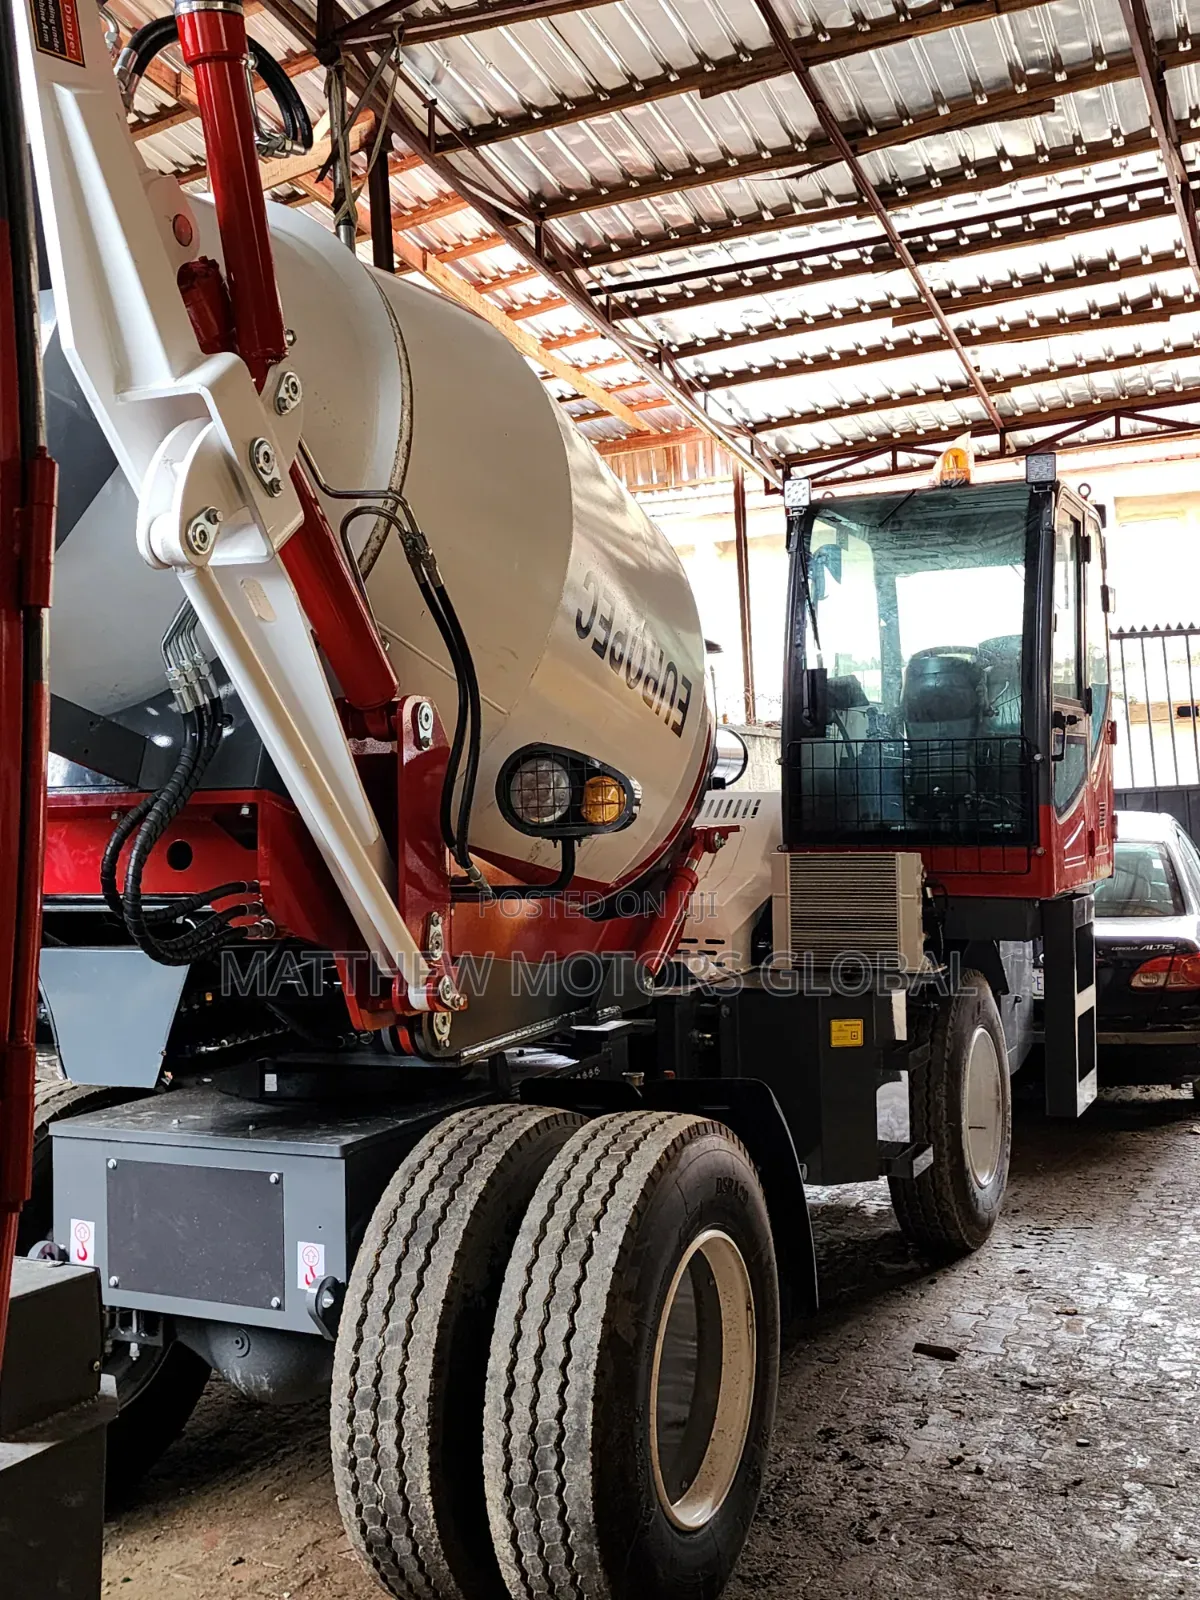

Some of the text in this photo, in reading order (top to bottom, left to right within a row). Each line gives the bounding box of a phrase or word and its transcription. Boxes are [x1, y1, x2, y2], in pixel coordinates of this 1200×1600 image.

[51, 26, 60, 52] under
[64, 3, 77, 56] Danger
[575, 570, 693, 738] EUROPEC
